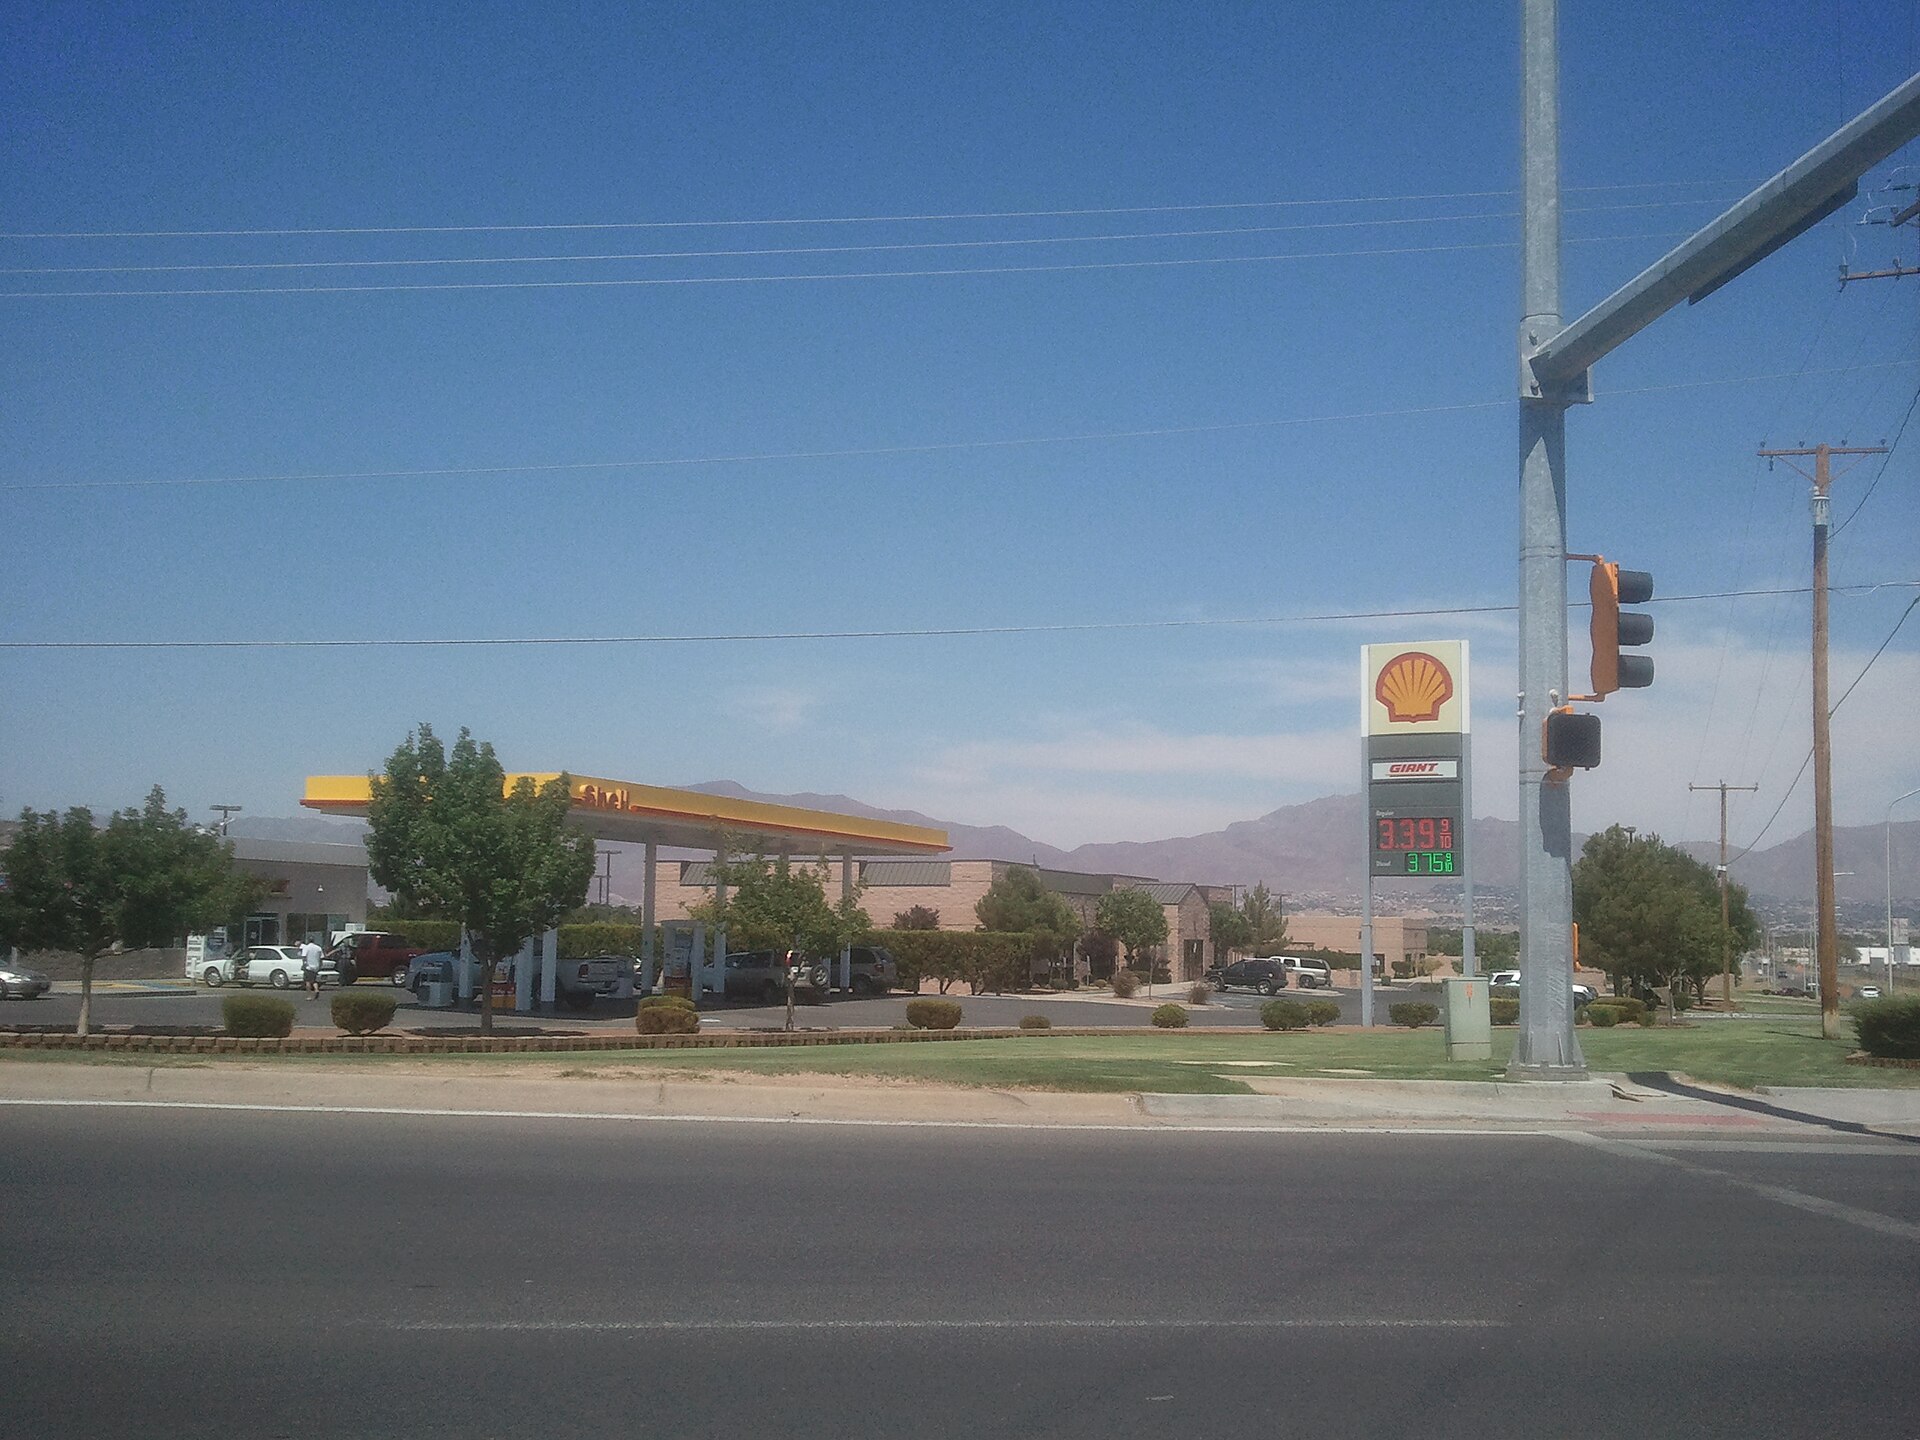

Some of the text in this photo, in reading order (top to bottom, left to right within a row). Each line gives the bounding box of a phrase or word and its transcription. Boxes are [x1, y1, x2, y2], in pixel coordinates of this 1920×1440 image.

[1389, 763, 1438, 773] GIANT
[584, 785, 629, 810] Shell
[1379, 819, 1434, 849] 3.39
[1408, 853, 1444, 872] 3.75
